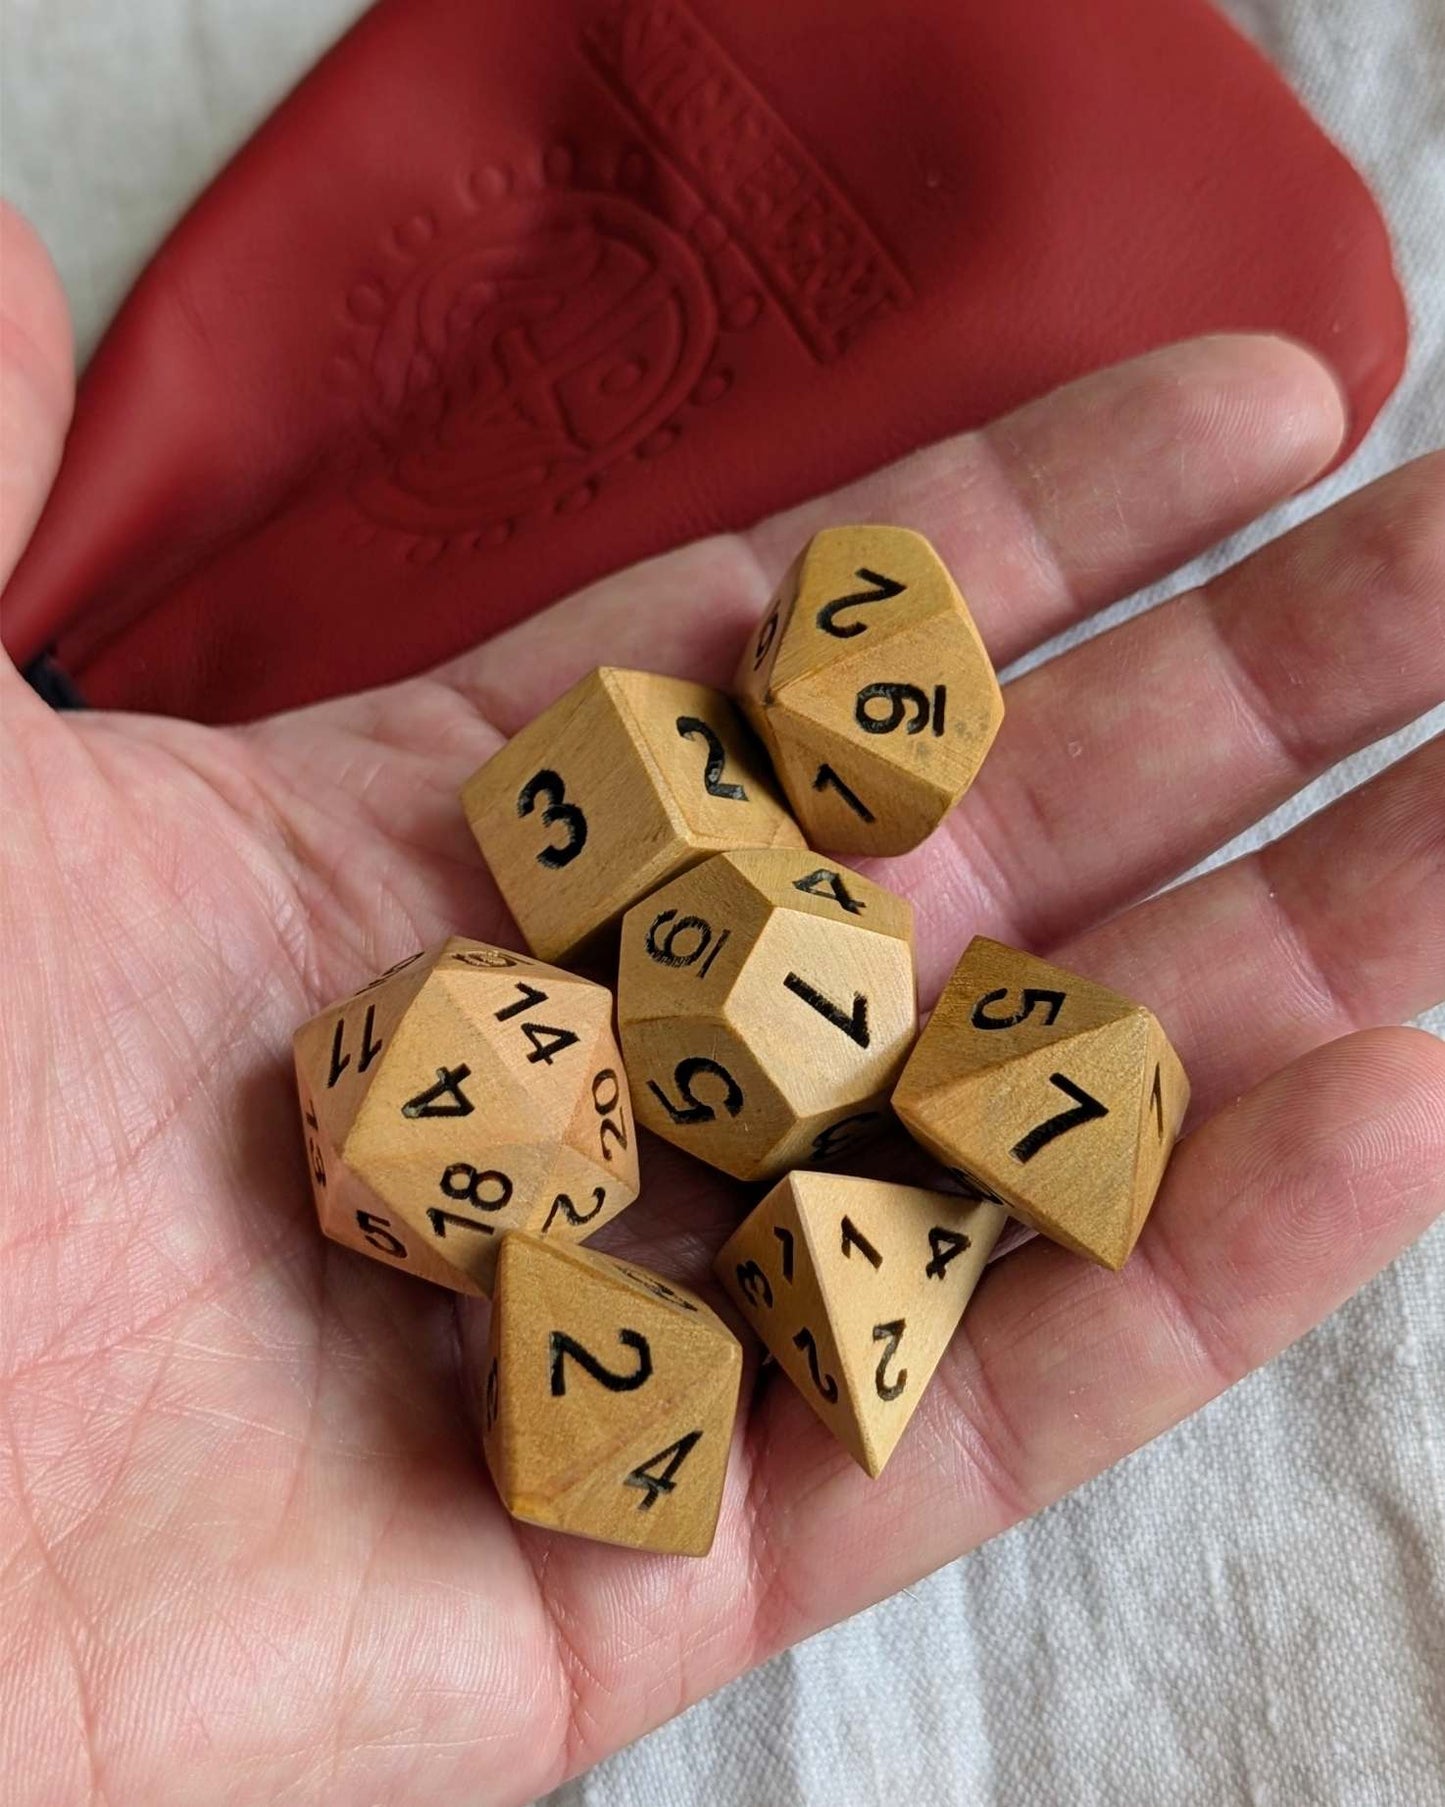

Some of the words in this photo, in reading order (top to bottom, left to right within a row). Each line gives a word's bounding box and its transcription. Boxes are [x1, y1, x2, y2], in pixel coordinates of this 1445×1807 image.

[816, 567, 907, 638] 2
[855, 682, 946, 737] 9
[676, 716, 749, 801] 2
[813, 763, 876, 823] 1
[518, 769, 587, 870] 3
[792, 868, 867, 915] 4
[644, 909, 731, 979] 6
[494, 981, 581, 1065] 14
[970, 987, 1066, 1030] 5
[327, 1004, 383, 1089] 11
[401, 1062, 475, 1118] 4
[592, 1068, 628, 1162] 20
[646, 1057, 744, 1125] 5
[1008, 1072, 1109, 1164] 7
[356, 1209, 407, 1259] 5
[426, 1163, 513, 1238] 18
[542, 1187, 606, 1233] 2
[774, 1226, 794, 1285] 1
[841, 1214, 883, 1272] 1
[926, 1226, 971, 1280] 4
[735, 1260, 774, 1309] 3
[549, 1328, 653, 1397] 2
[792, 1327, 839, 1404] 2
[873, 1318, 907, 1402] 2
[623, 1430, 704, 1514] 4
